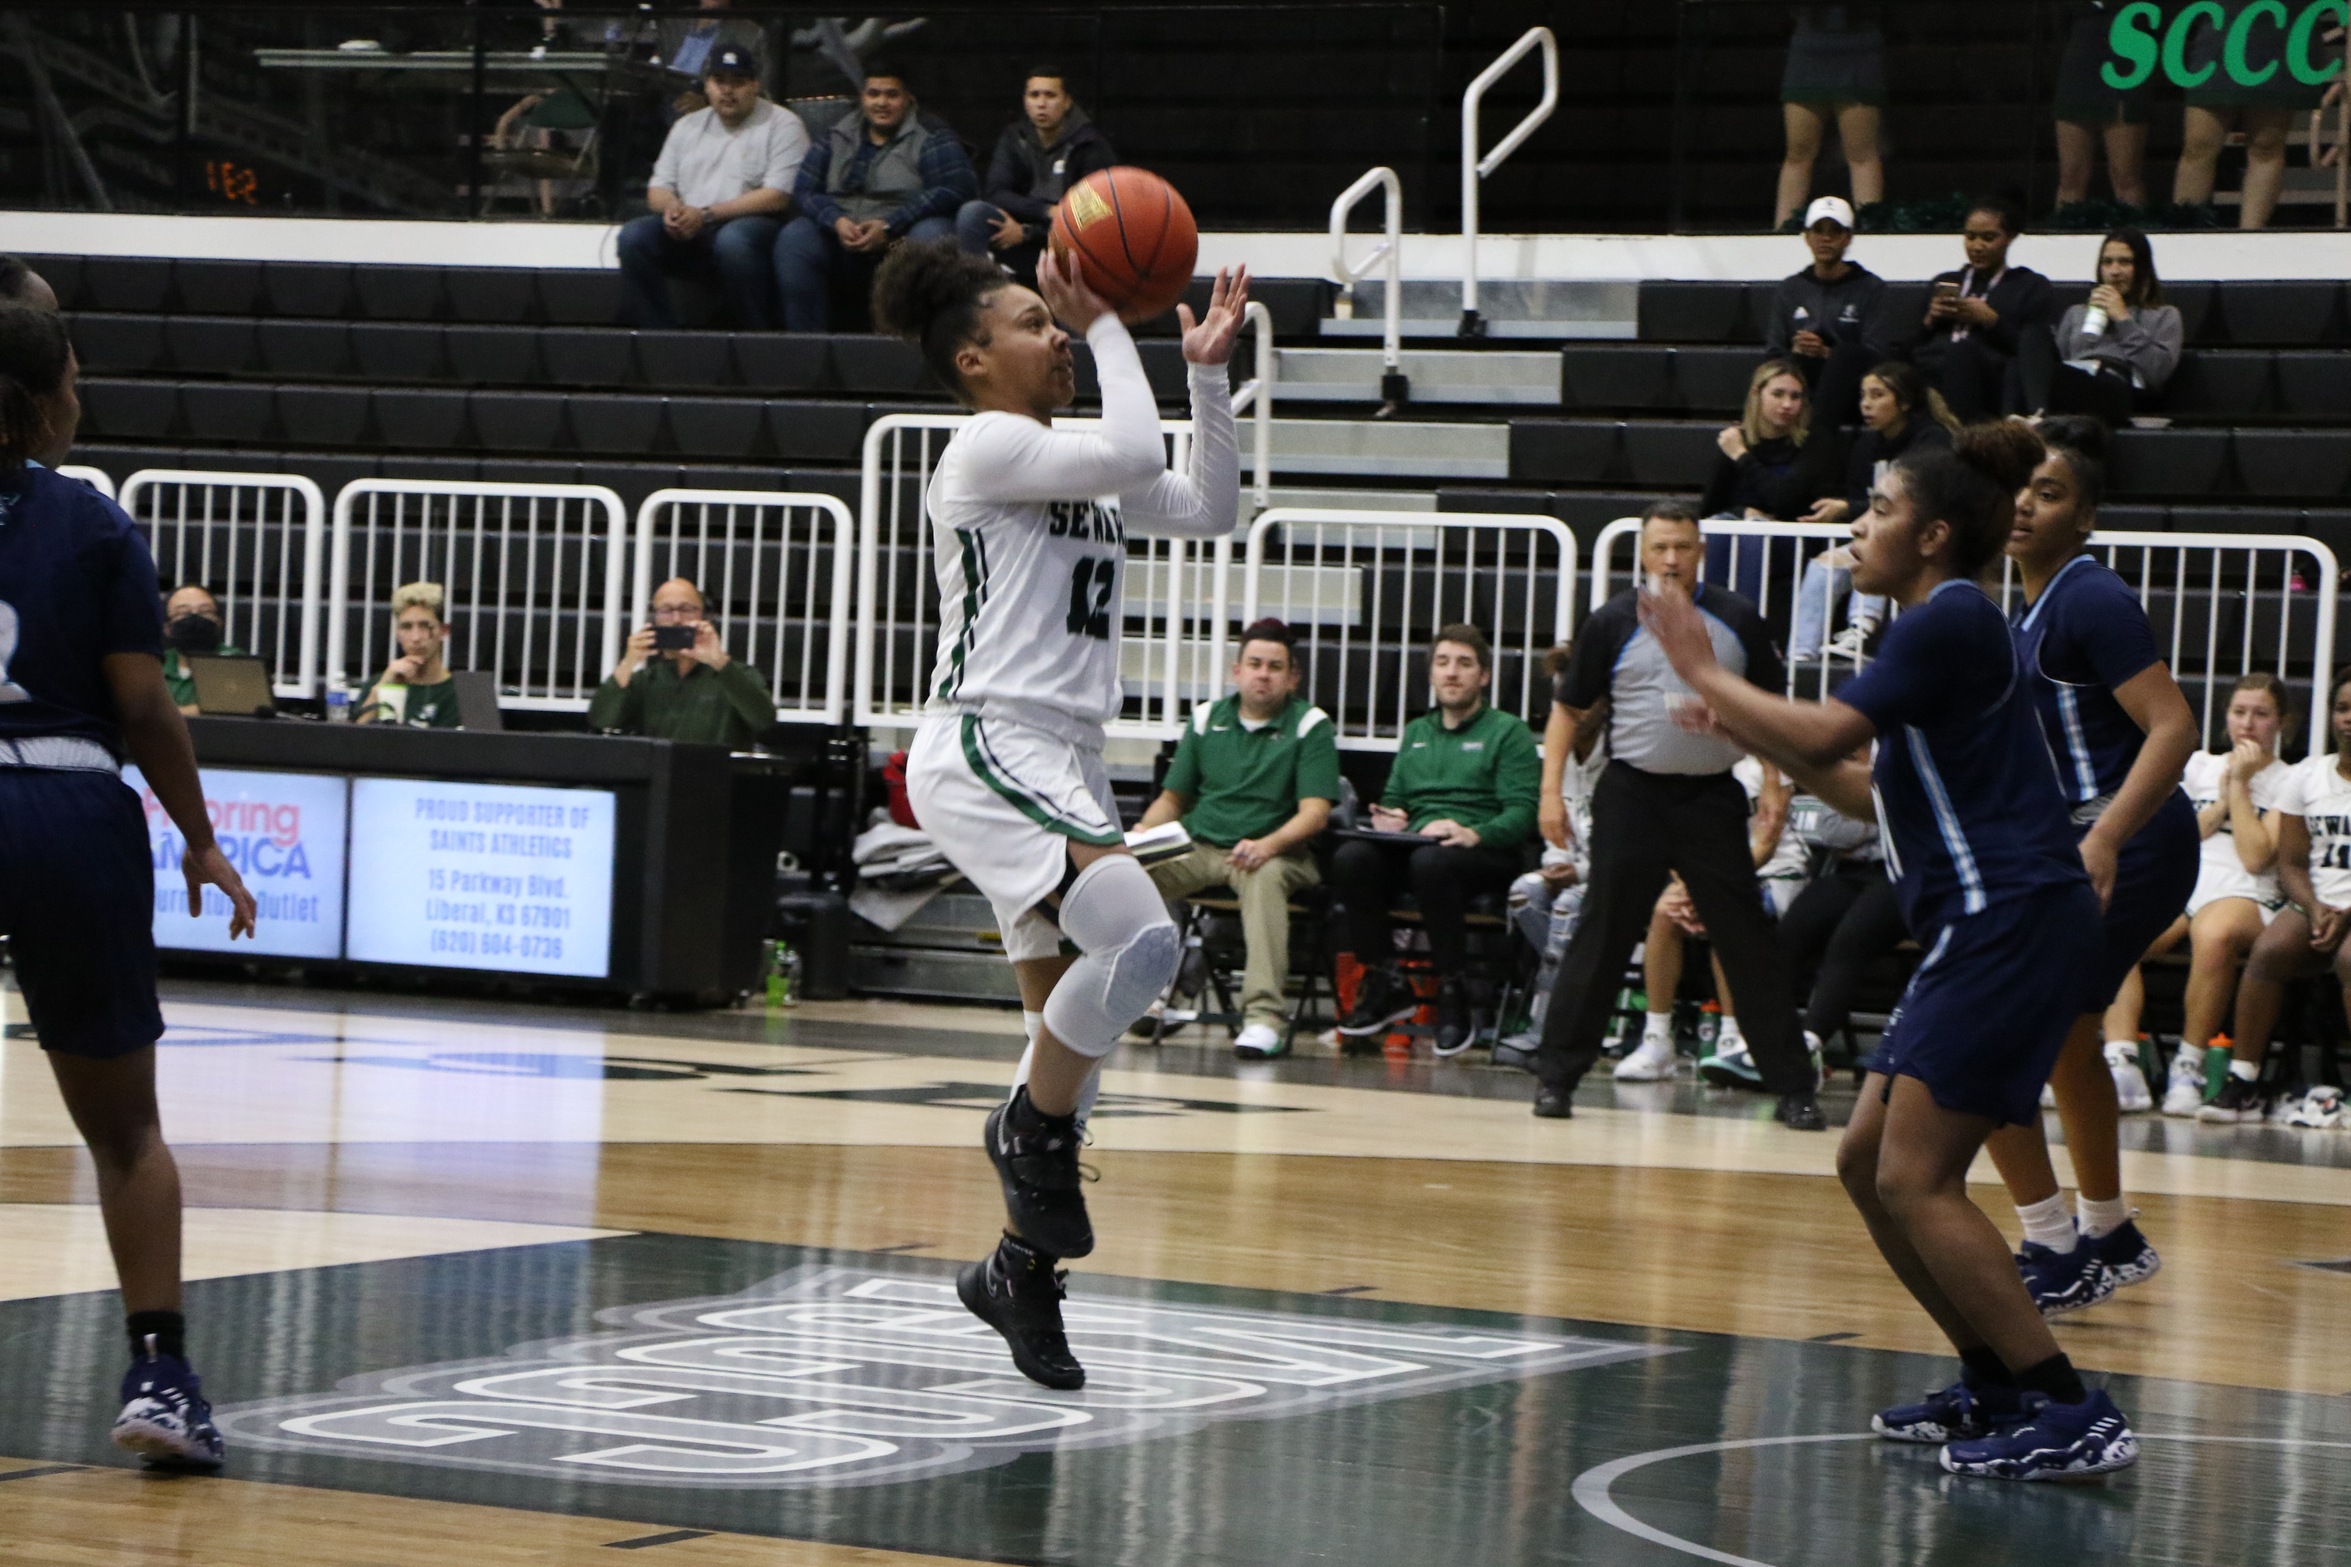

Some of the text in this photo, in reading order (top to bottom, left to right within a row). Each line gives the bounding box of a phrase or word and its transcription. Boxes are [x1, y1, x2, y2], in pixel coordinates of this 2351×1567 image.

[1066, 555, 1115, 638] 12
[415, 797, 590, 829] PROUD SUPPORTER OF
[430, 828, 573, 859] SAINTS ATHLETICS
[428, 868, 446, 891] 15
[450, 869, 523, 899] Parkway
[255, 890, 319, 924] Outlet
[496, 903, 516, 925] KS
[520, 904, 571, 929] 67901
